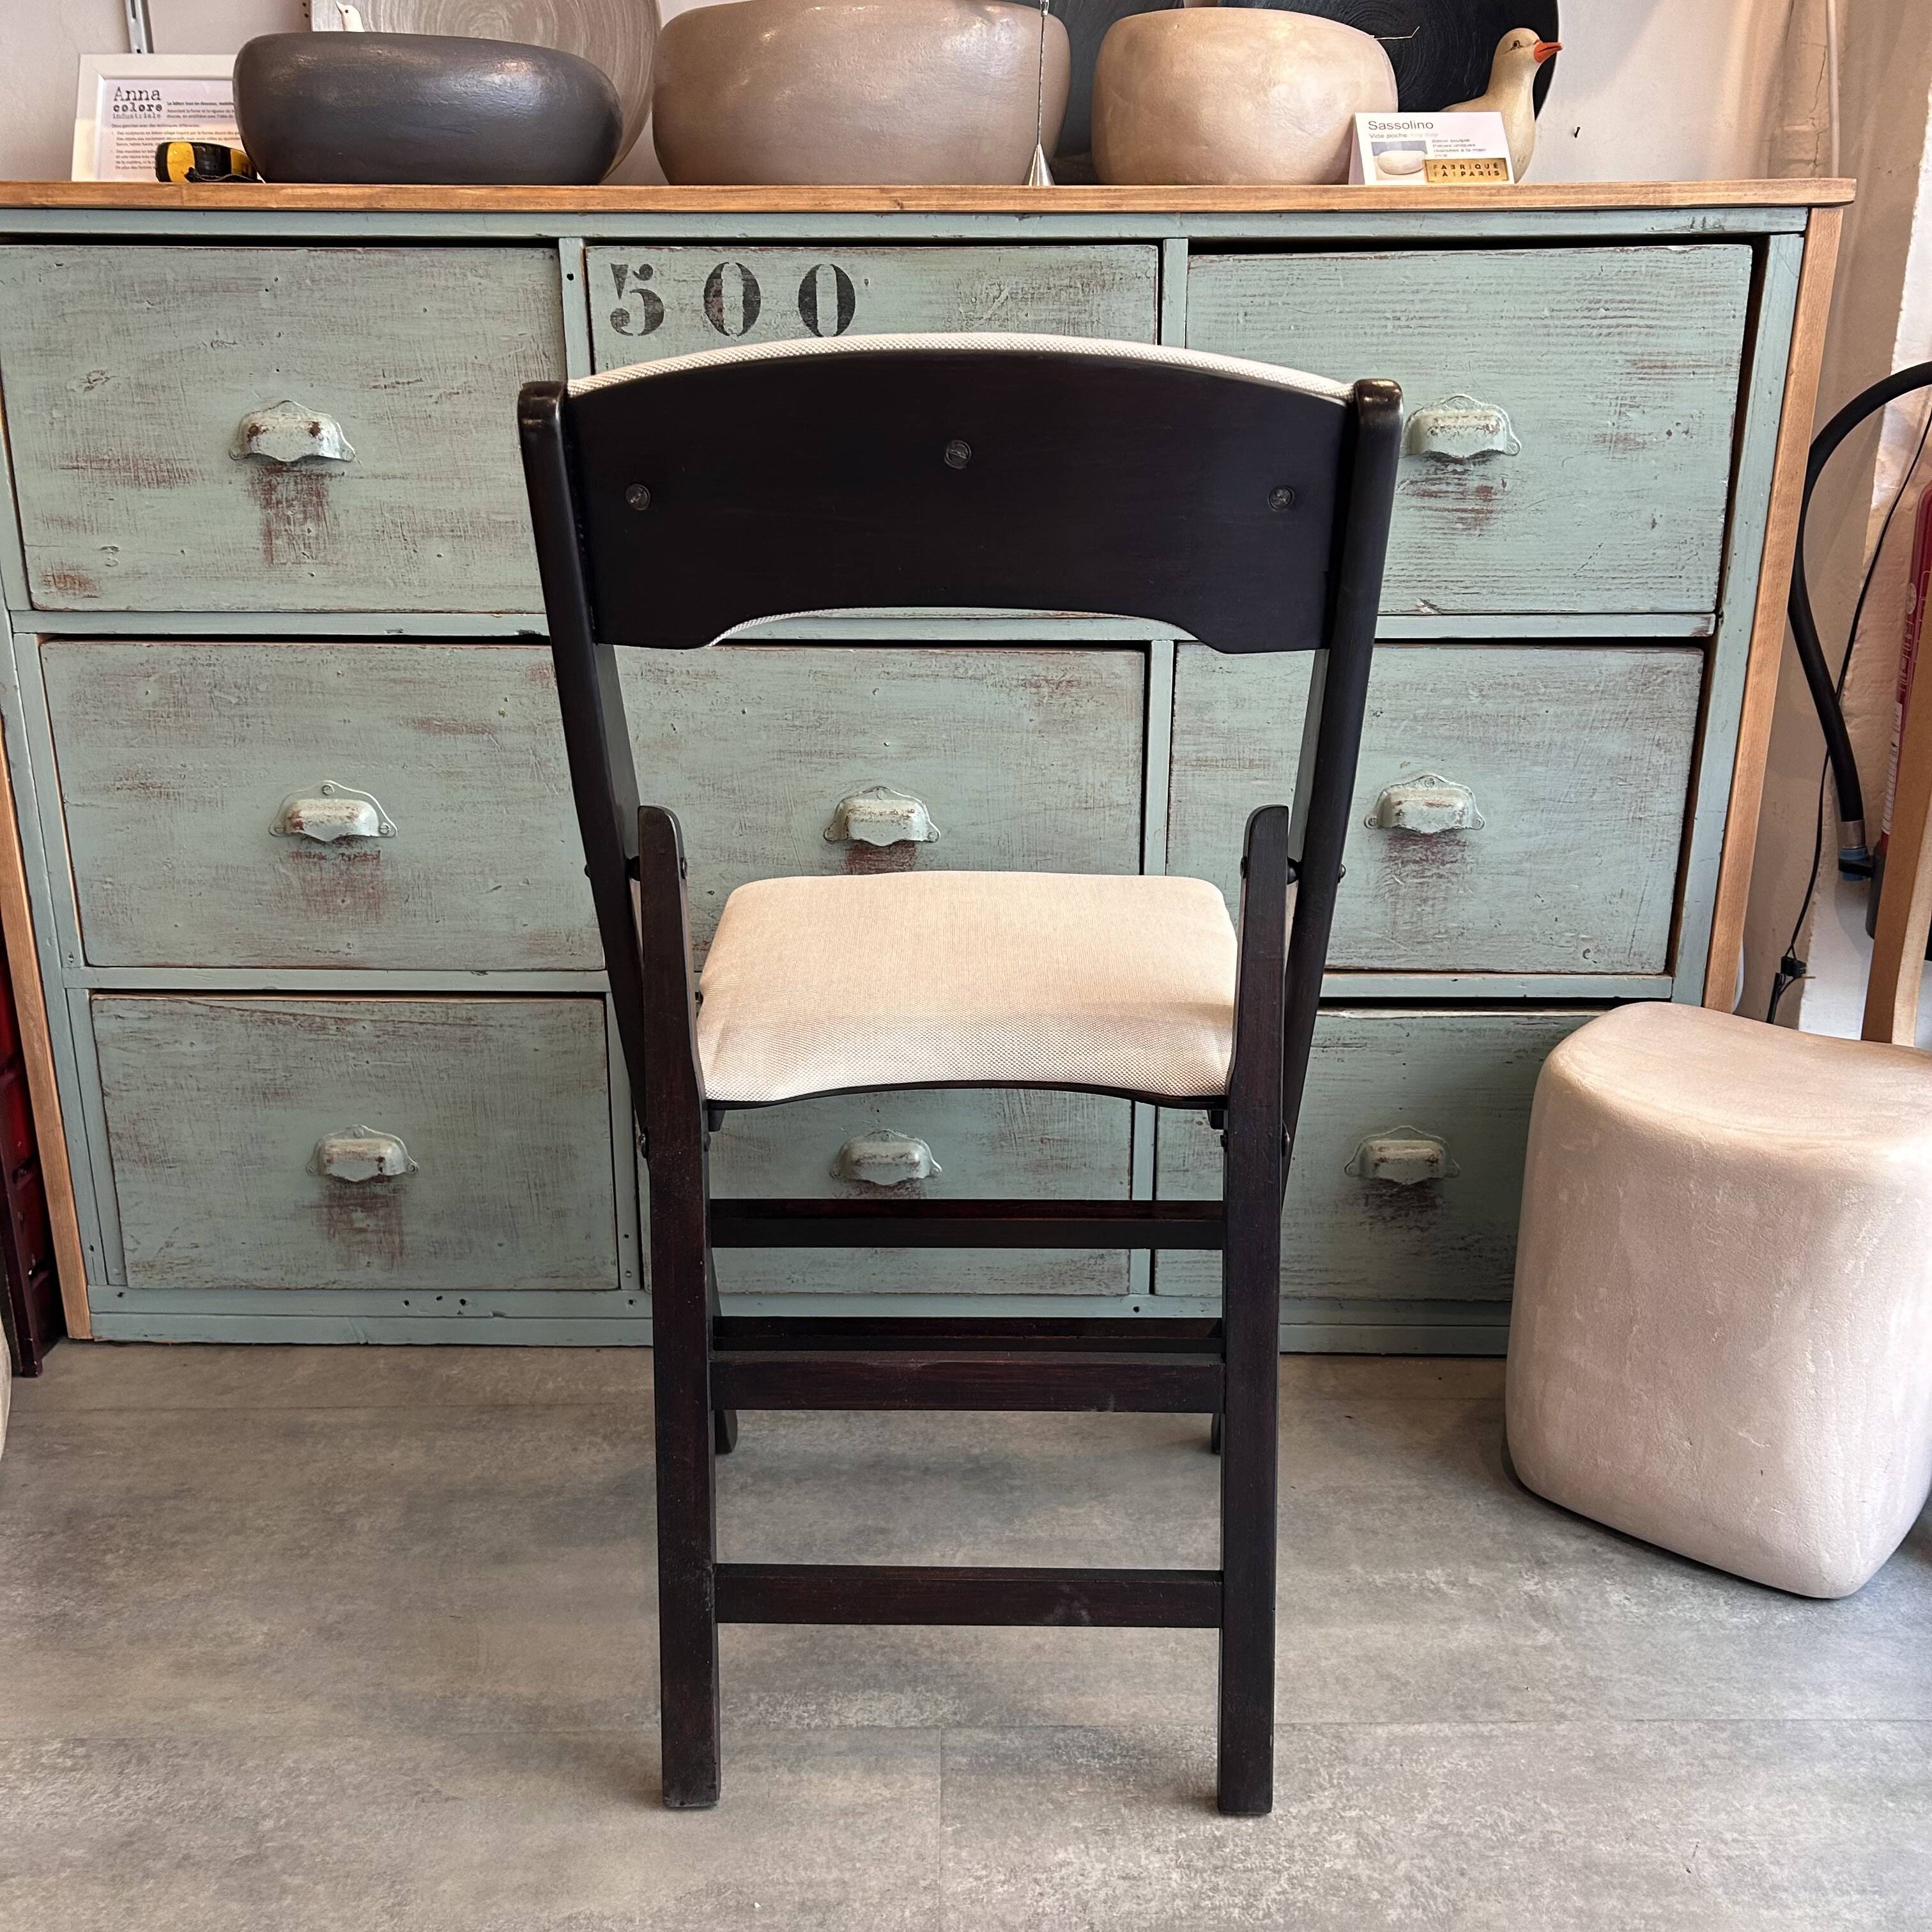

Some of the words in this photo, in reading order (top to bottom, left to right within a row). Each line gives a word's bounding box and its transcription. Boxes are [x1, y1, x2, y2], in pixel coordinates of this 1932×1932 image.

[113, 87, 161, 101] Anna
[113, 102, 162, 112] colore
[1368, 120, 1434, 130] Sassolino
